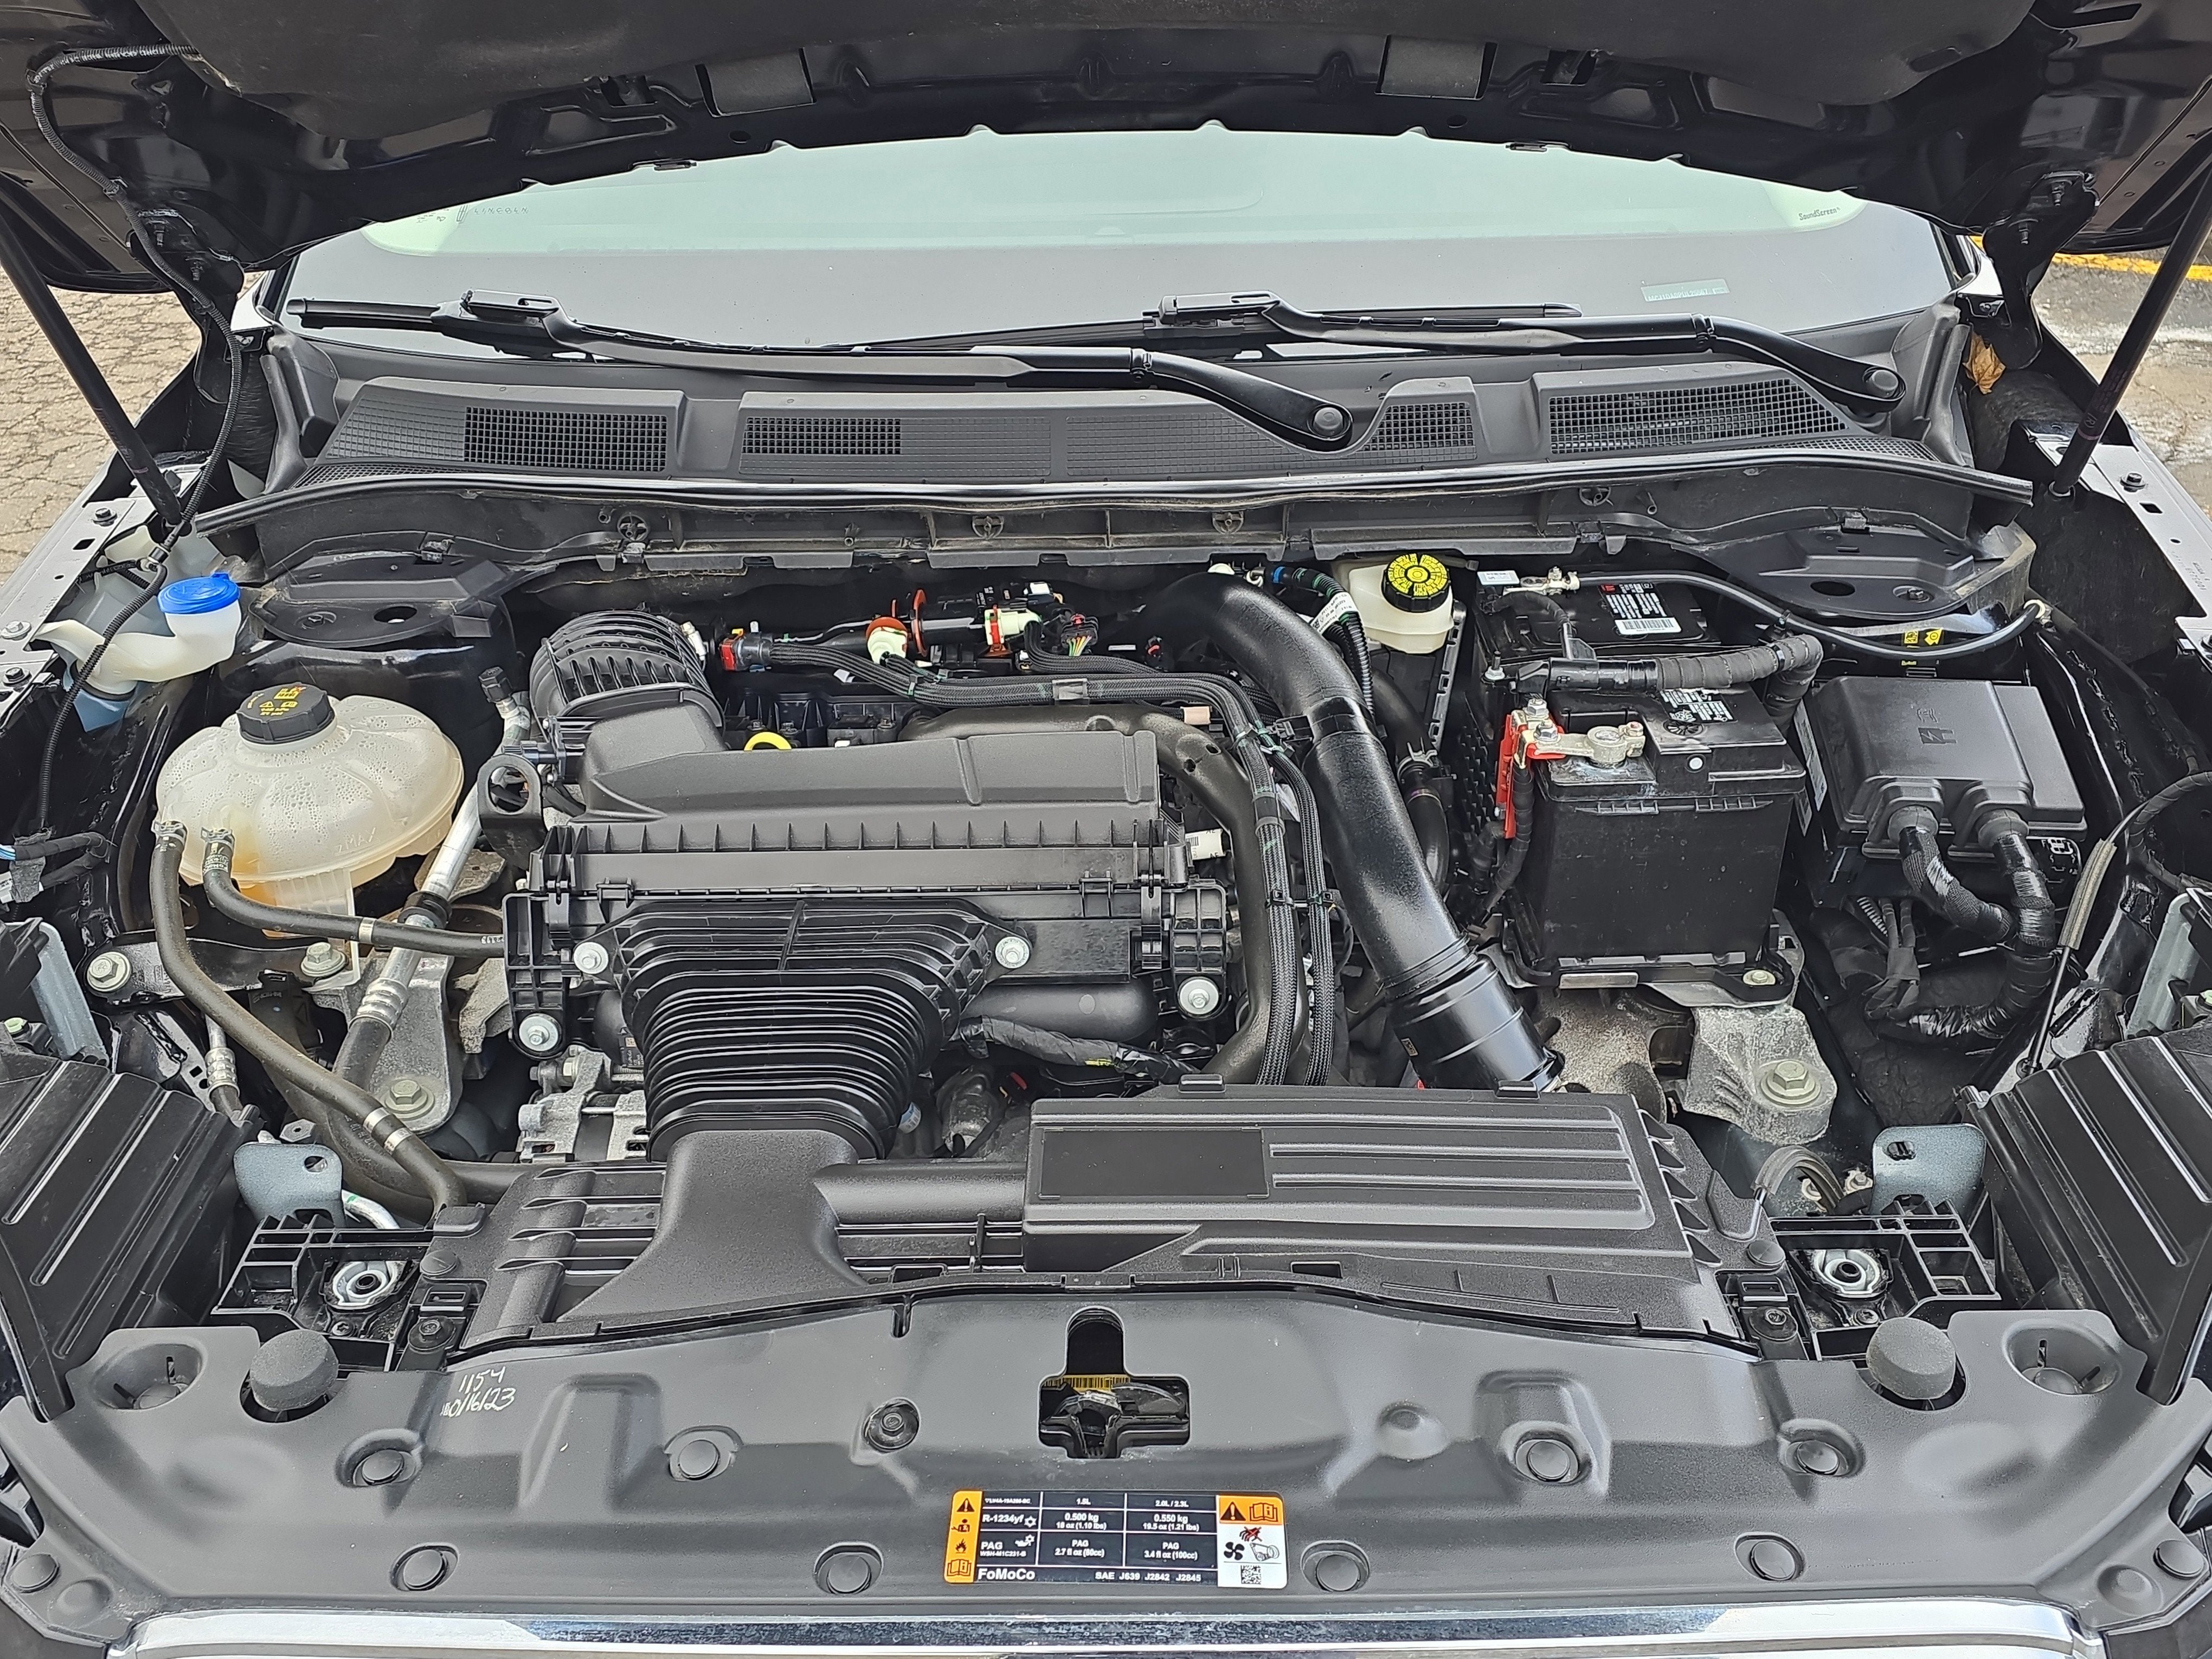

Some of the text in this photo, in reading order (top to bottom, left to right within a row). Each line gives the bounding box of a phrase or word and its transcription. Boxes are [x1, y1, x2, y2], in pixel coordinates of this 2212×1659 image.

[458, 1366, 506, 1394] 1154
[982, 1514, 1025, 1525] R-1234yf
[1064, 1512, 1099, 1523] 0.500 kg
[1154, 1513, 1188, 1524] 0.550 kg
[1075, 1521, 1093, 1530] (1.10
[1168, 1522, 1184, 1532] (1.21
[1185, 1523, 1200, 1532] lbs)
[980, 1541, 1003, 1549] PAG
[1071, 1539, 1089, 1547] PAG
[1162, 1542, 1180, 1550] PAG
[1054, 1547, 1066, 1556] 2.7
[1143, 1550, 1155, 1558] 3.4
[1172, 1551, 1198, 1561] (100cc)
[978, 1567, 1036, 1580] FoMoCo
[1095, 1572, 1201, 1582] SAE J639 J2842 J2845
